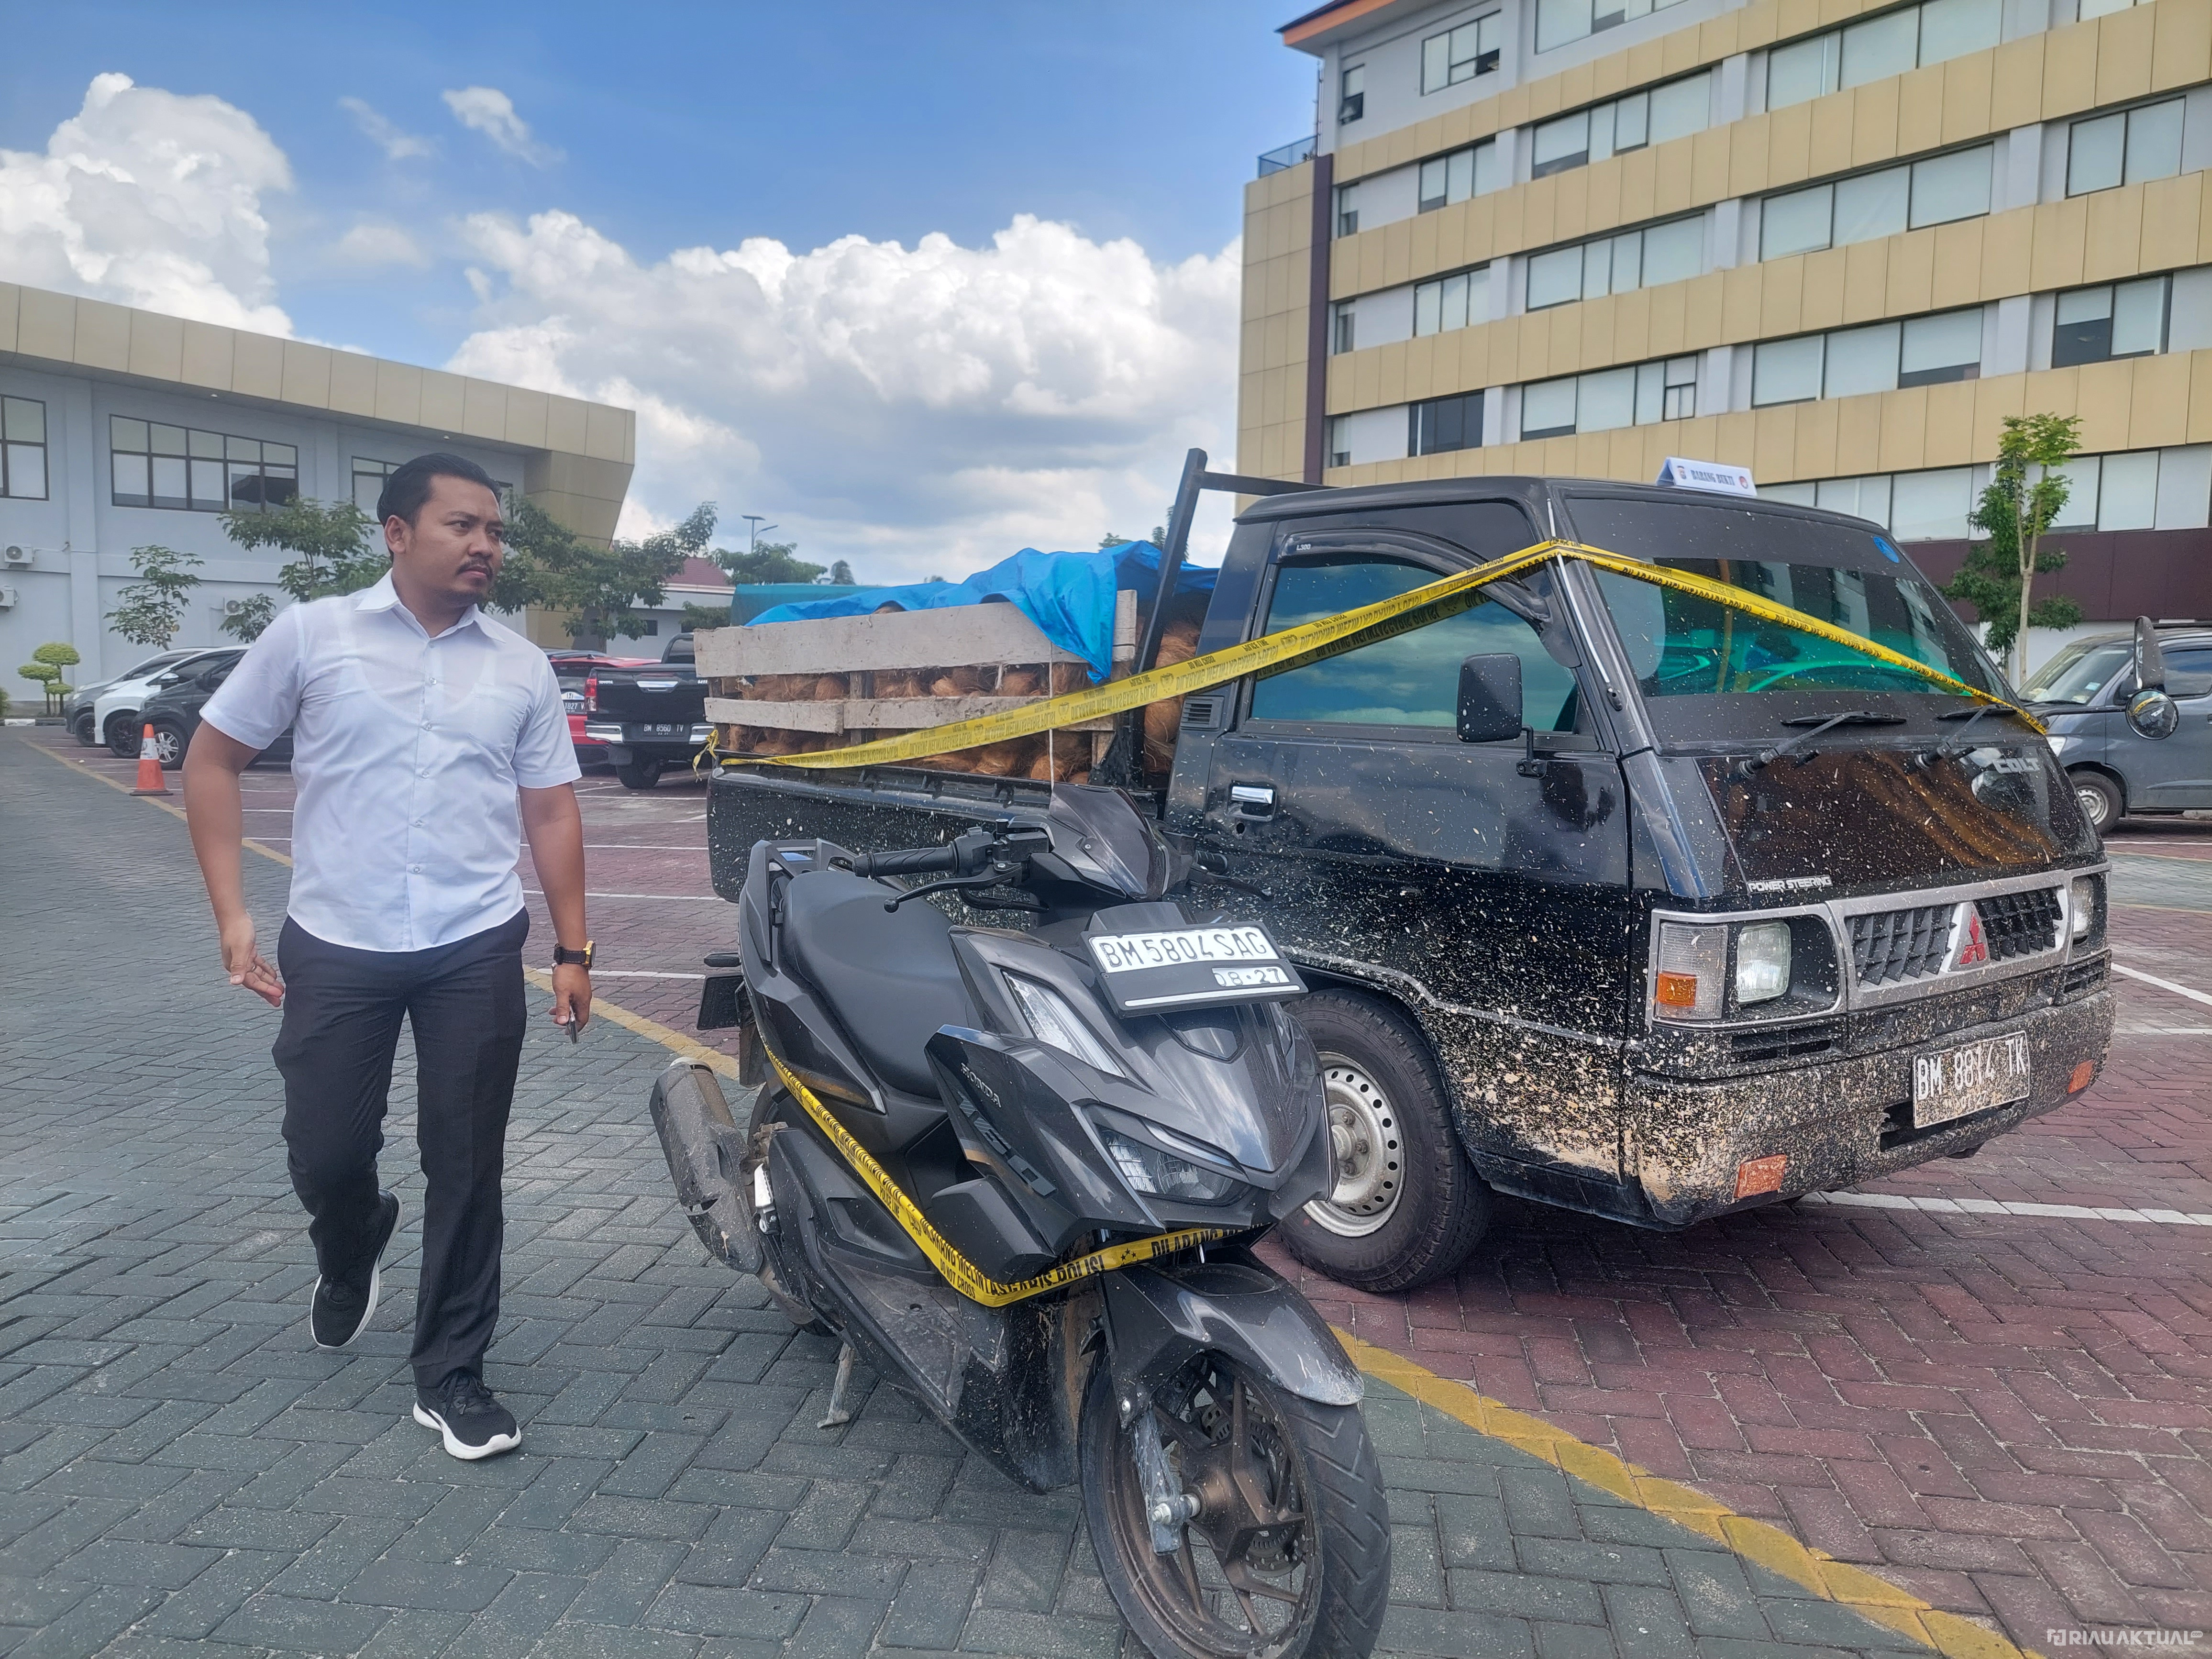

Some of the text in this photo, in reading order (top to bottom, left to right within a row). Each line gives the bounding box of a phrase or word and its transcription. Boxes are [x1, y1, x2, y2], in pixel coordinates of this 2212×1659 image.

[1690, 470, 1735, 486] BARANG BUKTI
[1992, 757, 2040, 774] COLT
[1748, 876, 1832, 892] POWER STEERING
[1100, 931, 1267, 968] BM 5804 SAG
[961, 1062, 1001, 1107] HONDA
[1917, 1037, 2026, 1100] BM 8814 TK
[880, 1185, 900, 1219] POLICE LINE
[940, 1258, 976, 1299] DO NOT CROSS
